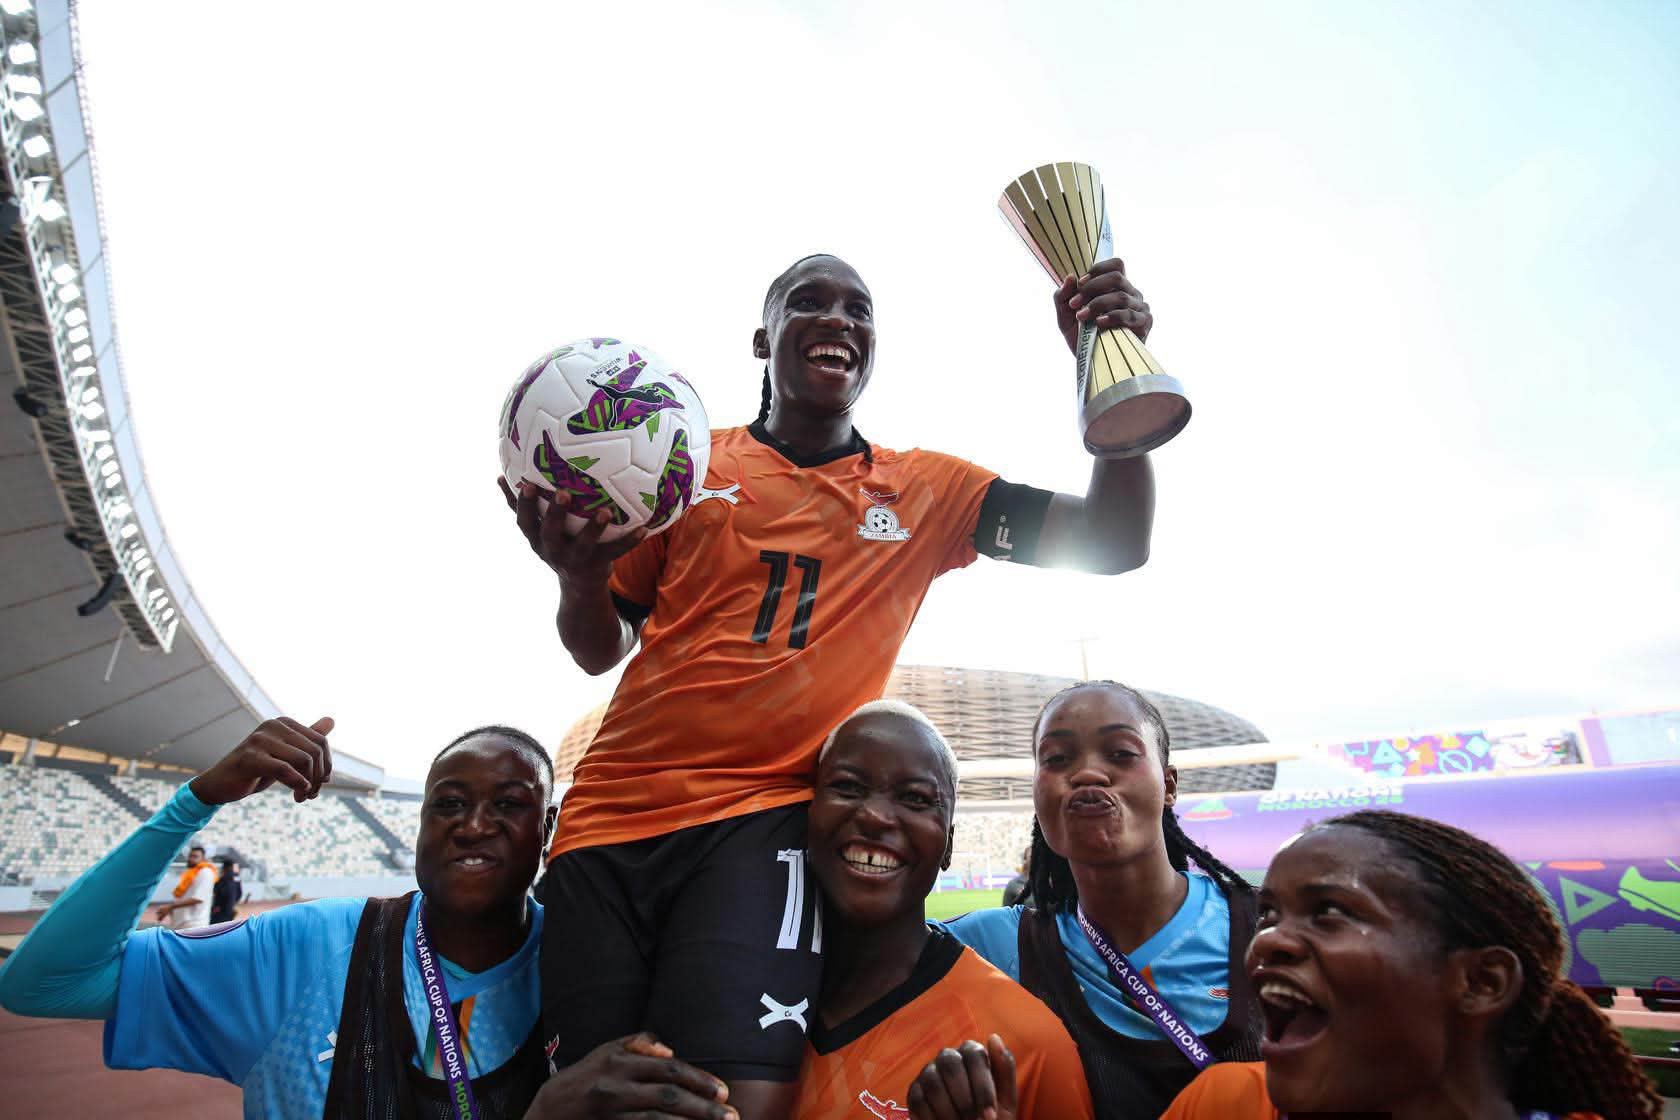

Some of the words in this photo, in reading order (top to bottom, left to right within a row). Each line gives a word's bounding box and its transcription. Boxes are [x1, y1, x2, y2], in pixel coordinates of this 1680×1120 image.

[752, 550, 822, 650] 11
[418, 946, 437, 985] AFRICA
[429, 985, 442, 1007] CUP
[435, 1007, 448, 1025] OF
[1099, 943, 1129, 978] AFRICA
[1127, 976, 1148, 996] CUP
[1145, 995, 1162, 1012] OF
[1158, 1009, 1208, 1062] NATIONS
[439, 1027, 462, 1079] NATIONS
